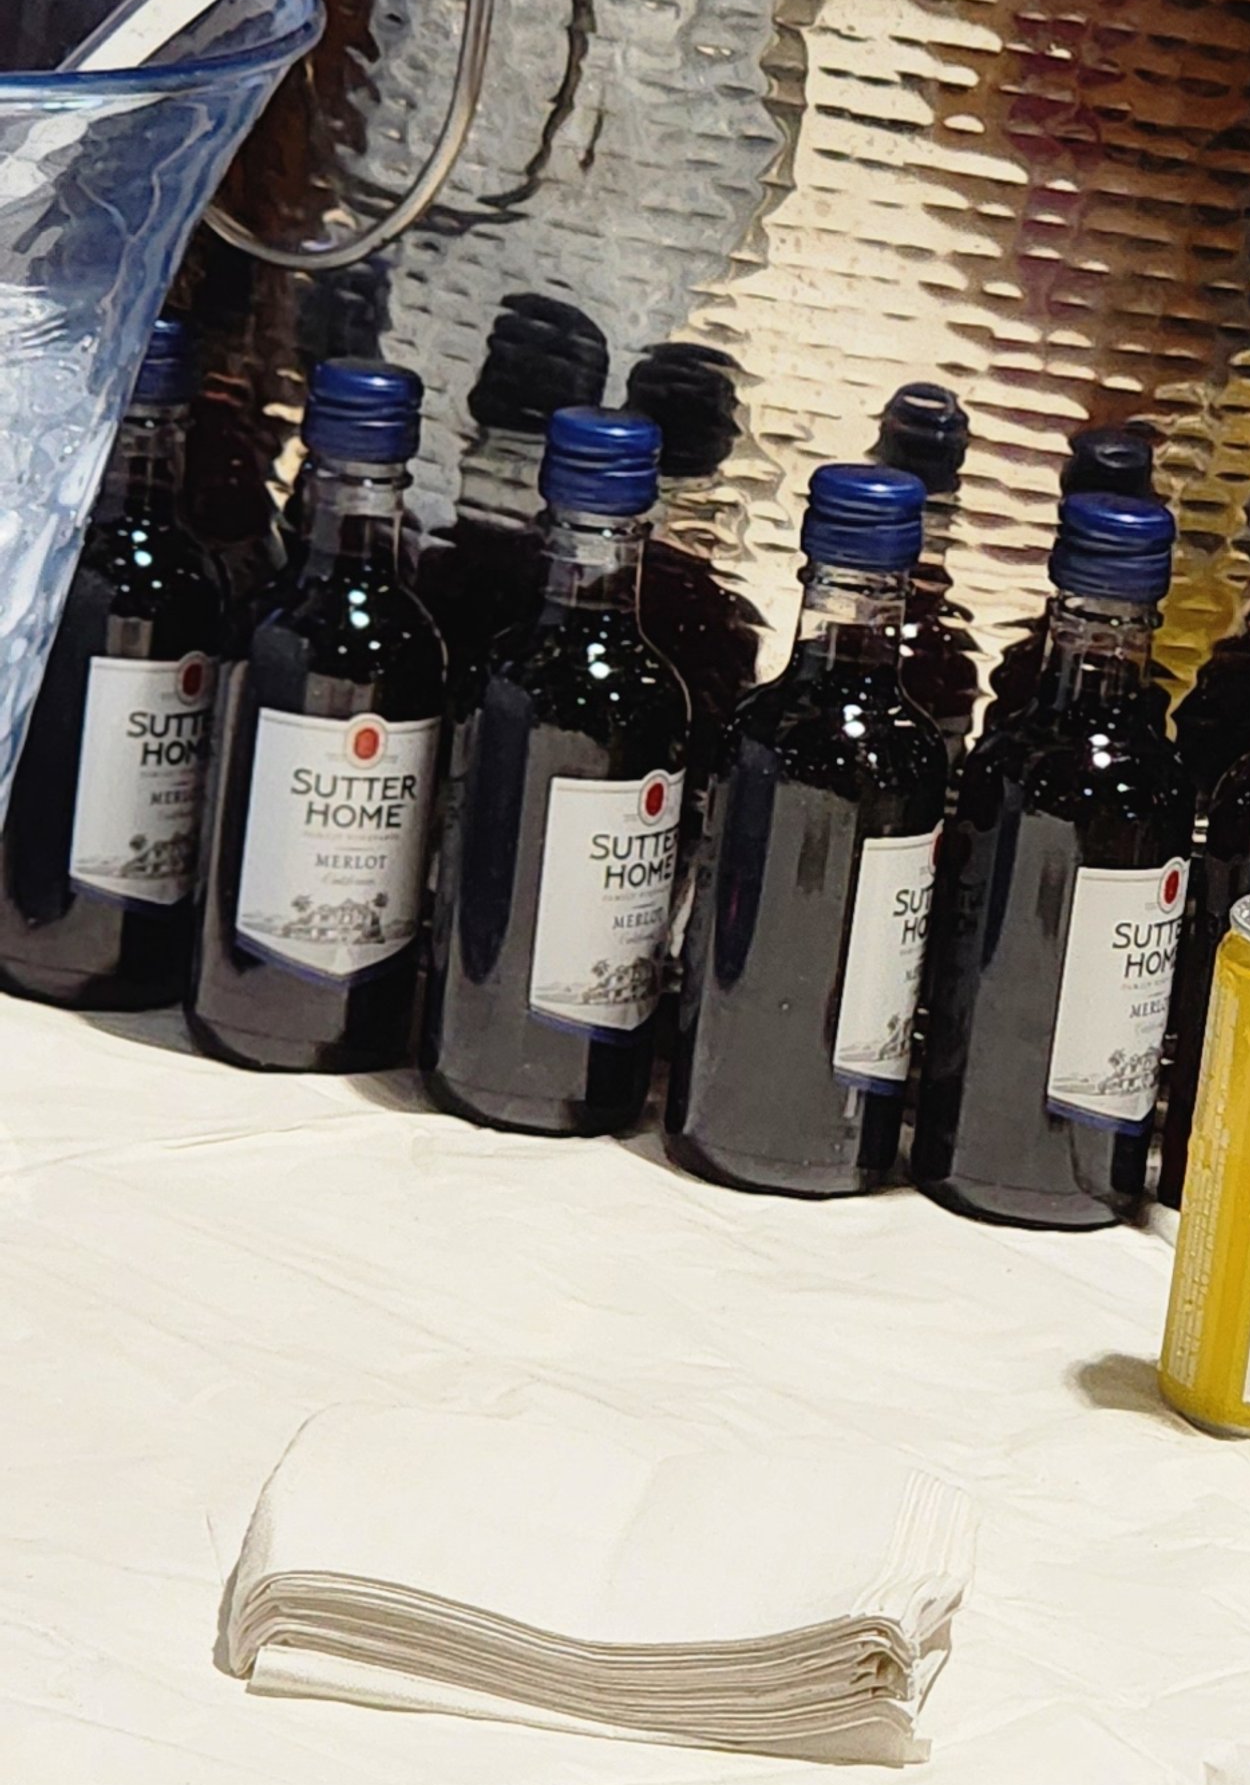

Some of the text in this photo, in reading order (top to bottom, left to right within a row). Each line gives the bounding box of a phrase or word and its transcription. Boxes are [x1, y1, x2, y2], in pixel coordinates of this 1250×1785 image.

[290, 768, 418, 802] SUTTER
[304, 801, 406, 830] HOME
[314, 853, 387, 870] MERLOT
[604, 854, 672, 888] HOME
